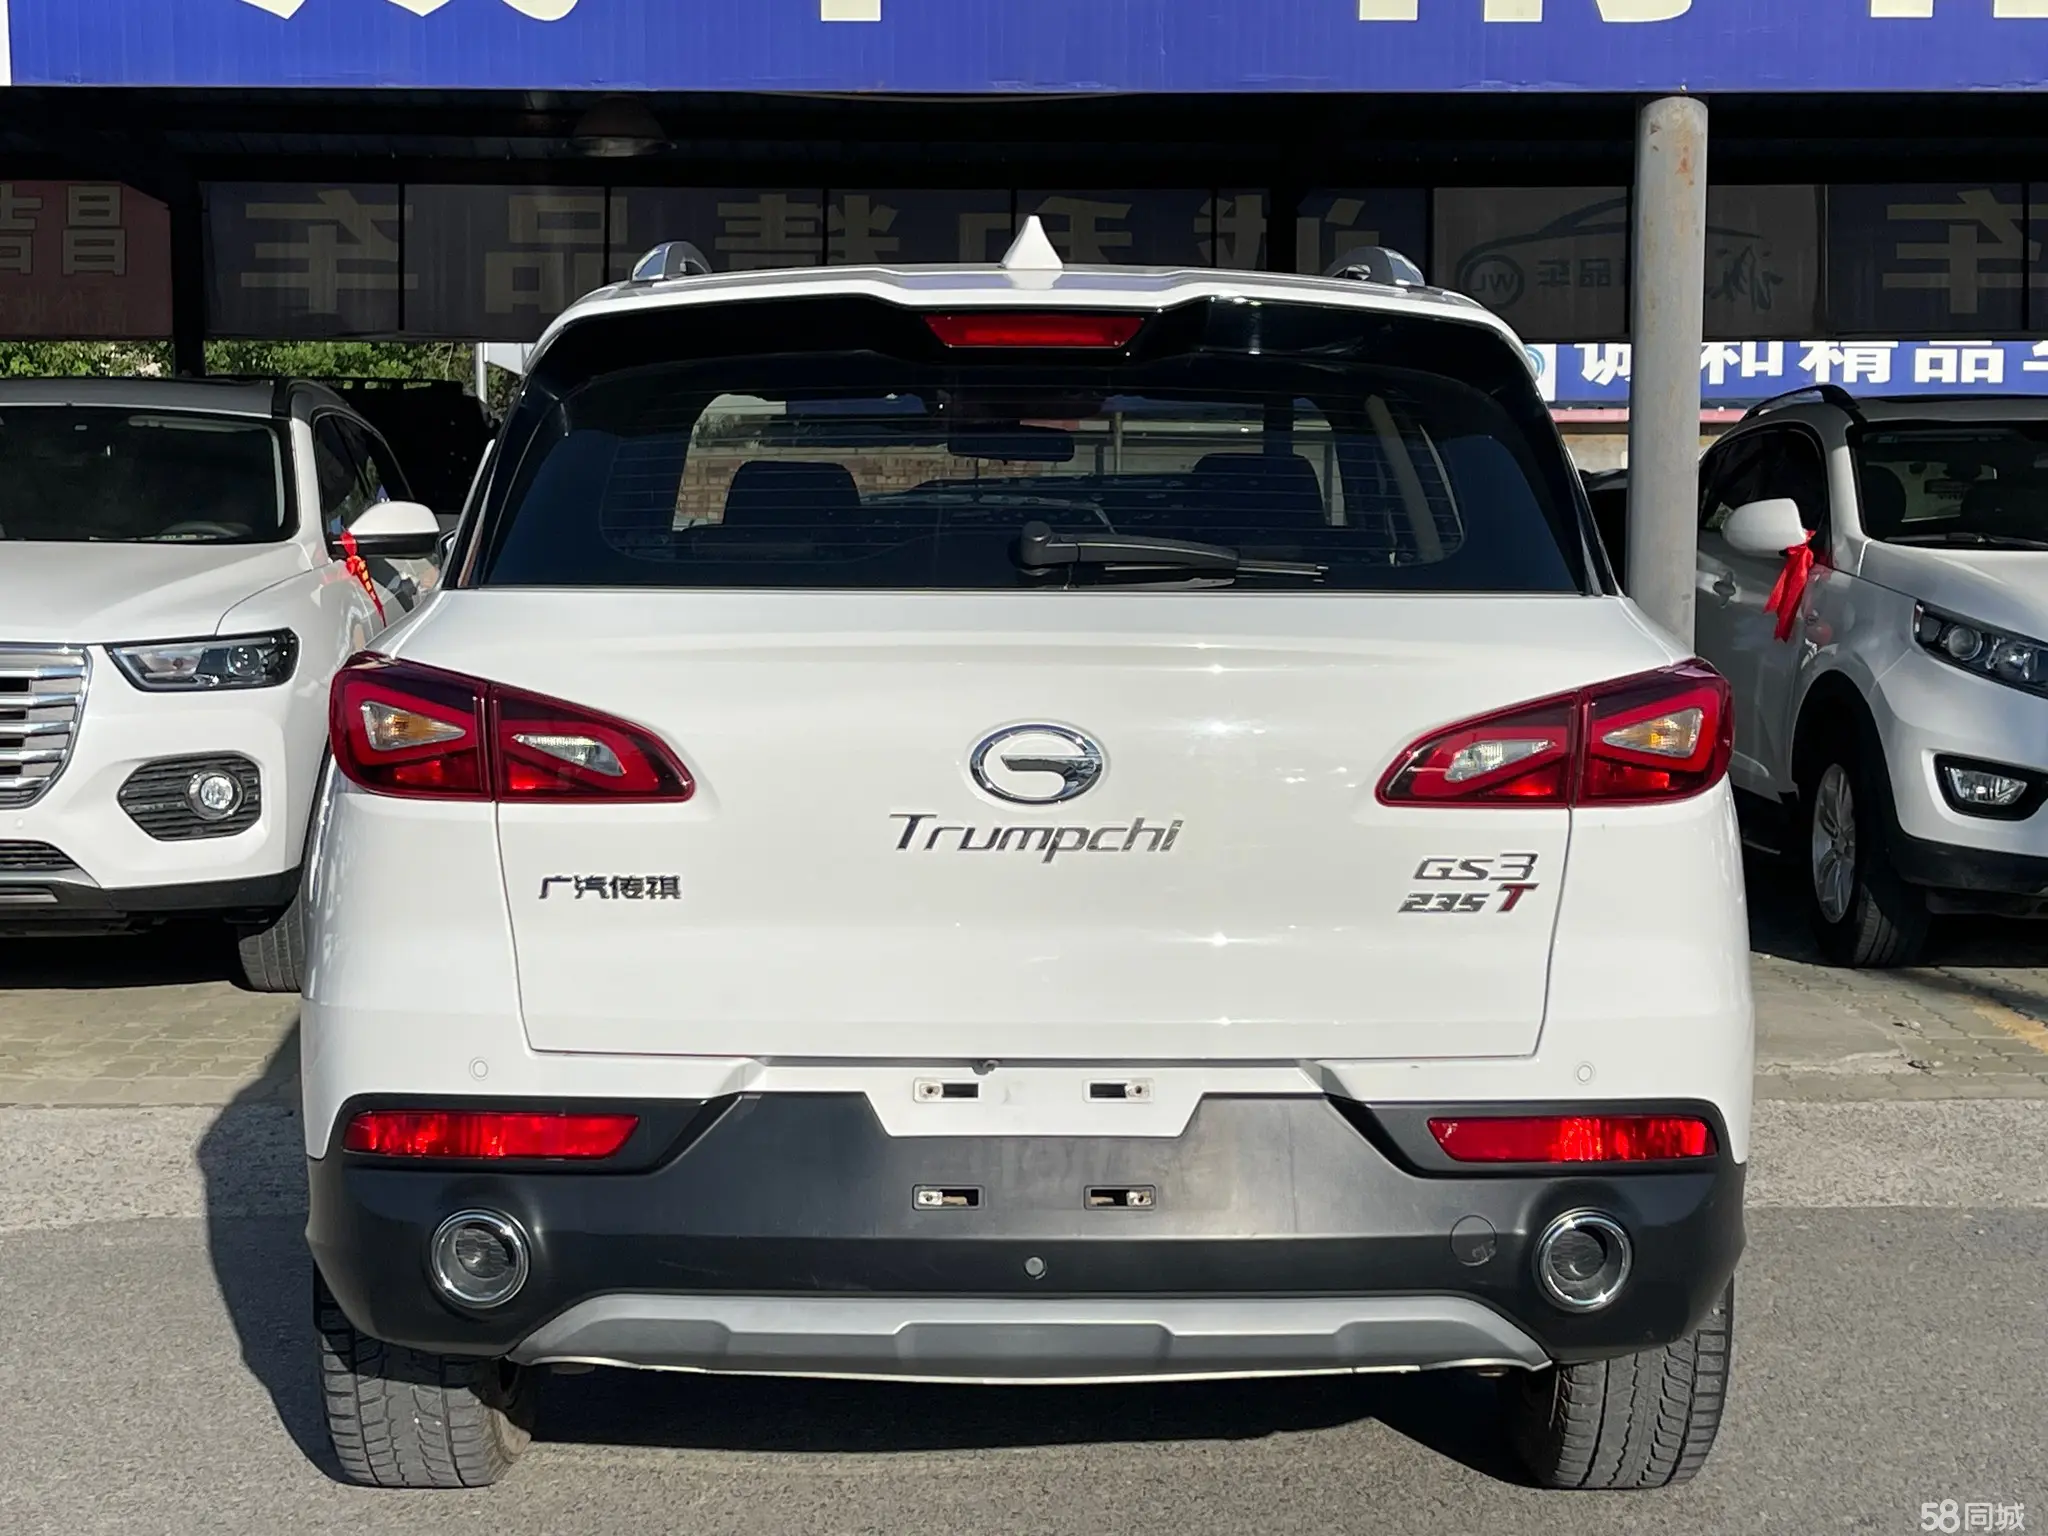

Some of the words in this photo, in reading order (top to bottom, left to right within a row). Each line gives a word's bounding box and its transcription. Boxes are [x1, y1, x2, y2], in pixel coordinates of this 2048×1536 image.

[889, 813, 1184, 863] Trumpchi
[1413, 852, 1539, 881] GS3
[538, 875, 682, 900] 广汽传祺
